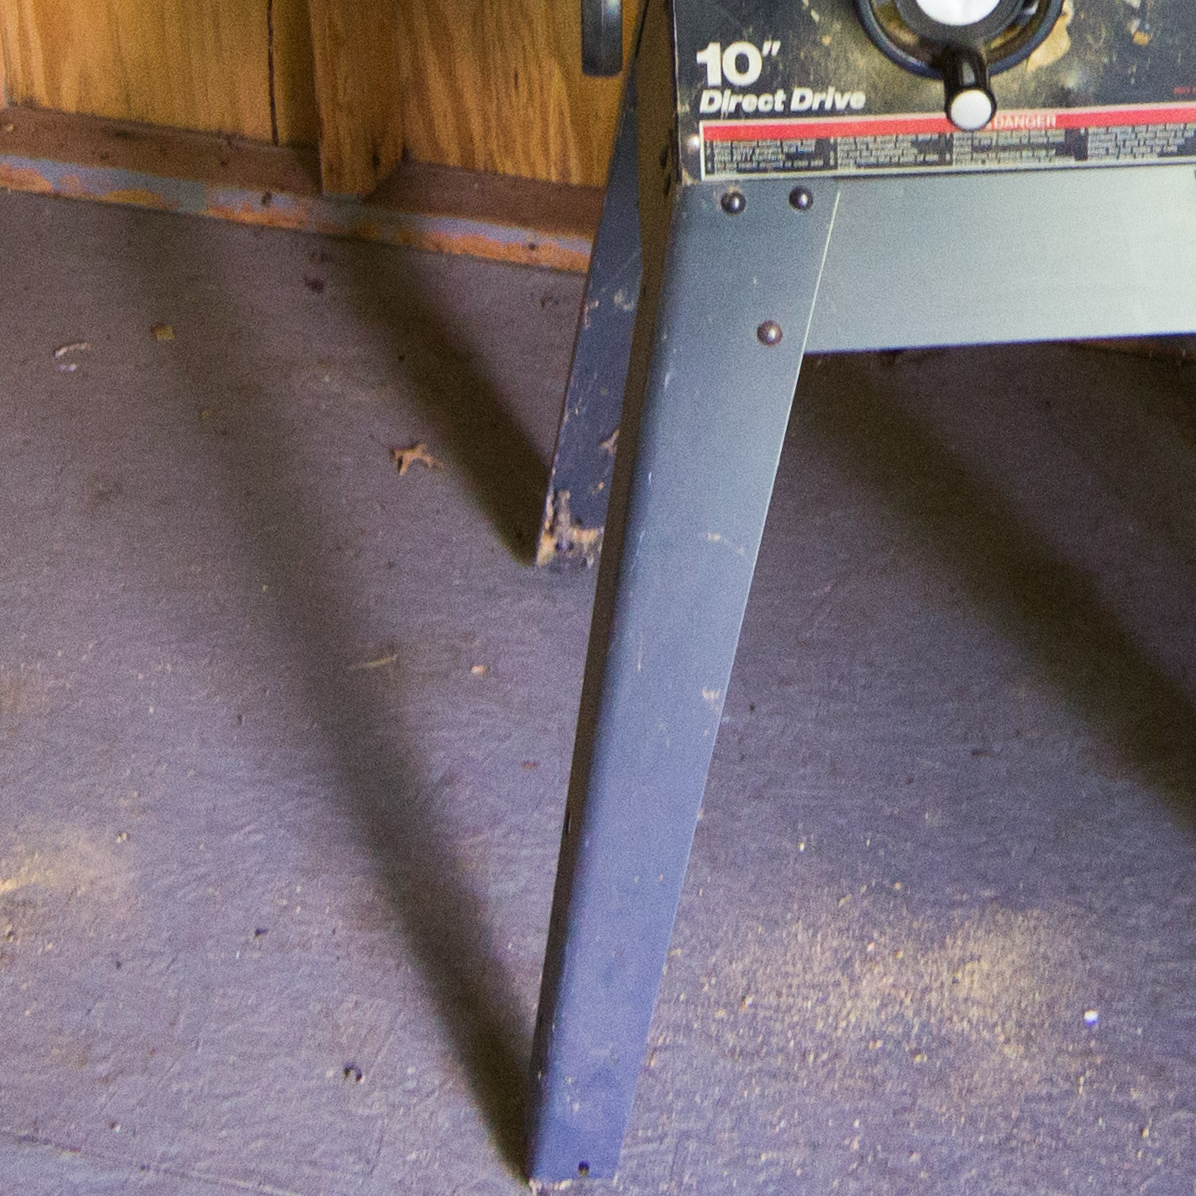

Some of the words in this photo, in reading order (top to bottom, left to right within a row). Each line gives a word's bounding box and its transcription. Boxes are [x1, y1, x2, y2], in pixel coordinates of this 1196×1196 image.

[700, 89, 786, 114] Direct
[790, 86, 866, 111] Drive
[994, 113, 1056, 129] DANGER
